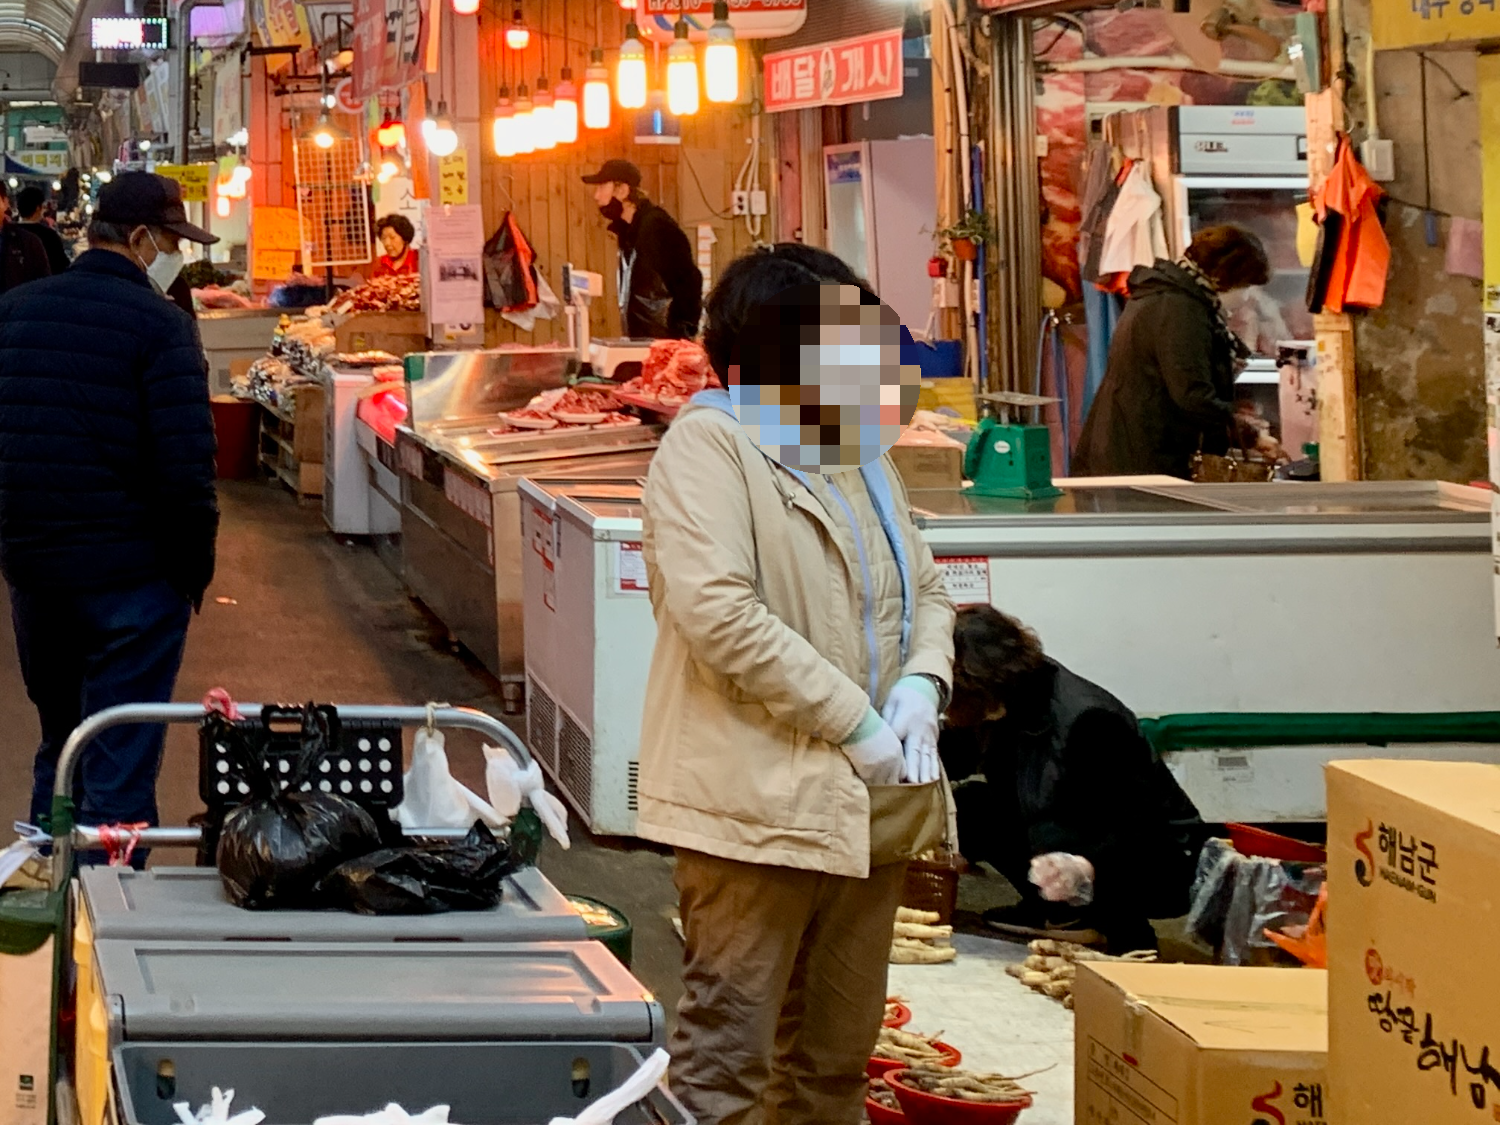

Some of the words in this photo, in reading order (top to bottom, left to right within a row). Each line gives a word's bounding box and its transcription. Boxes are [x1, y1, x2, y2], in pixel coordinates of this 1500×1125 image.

[770, 55, 817, 102] 배달
[839, 38, 894, 92] 개시
[1378, 821, 1439, 887] 해남군
